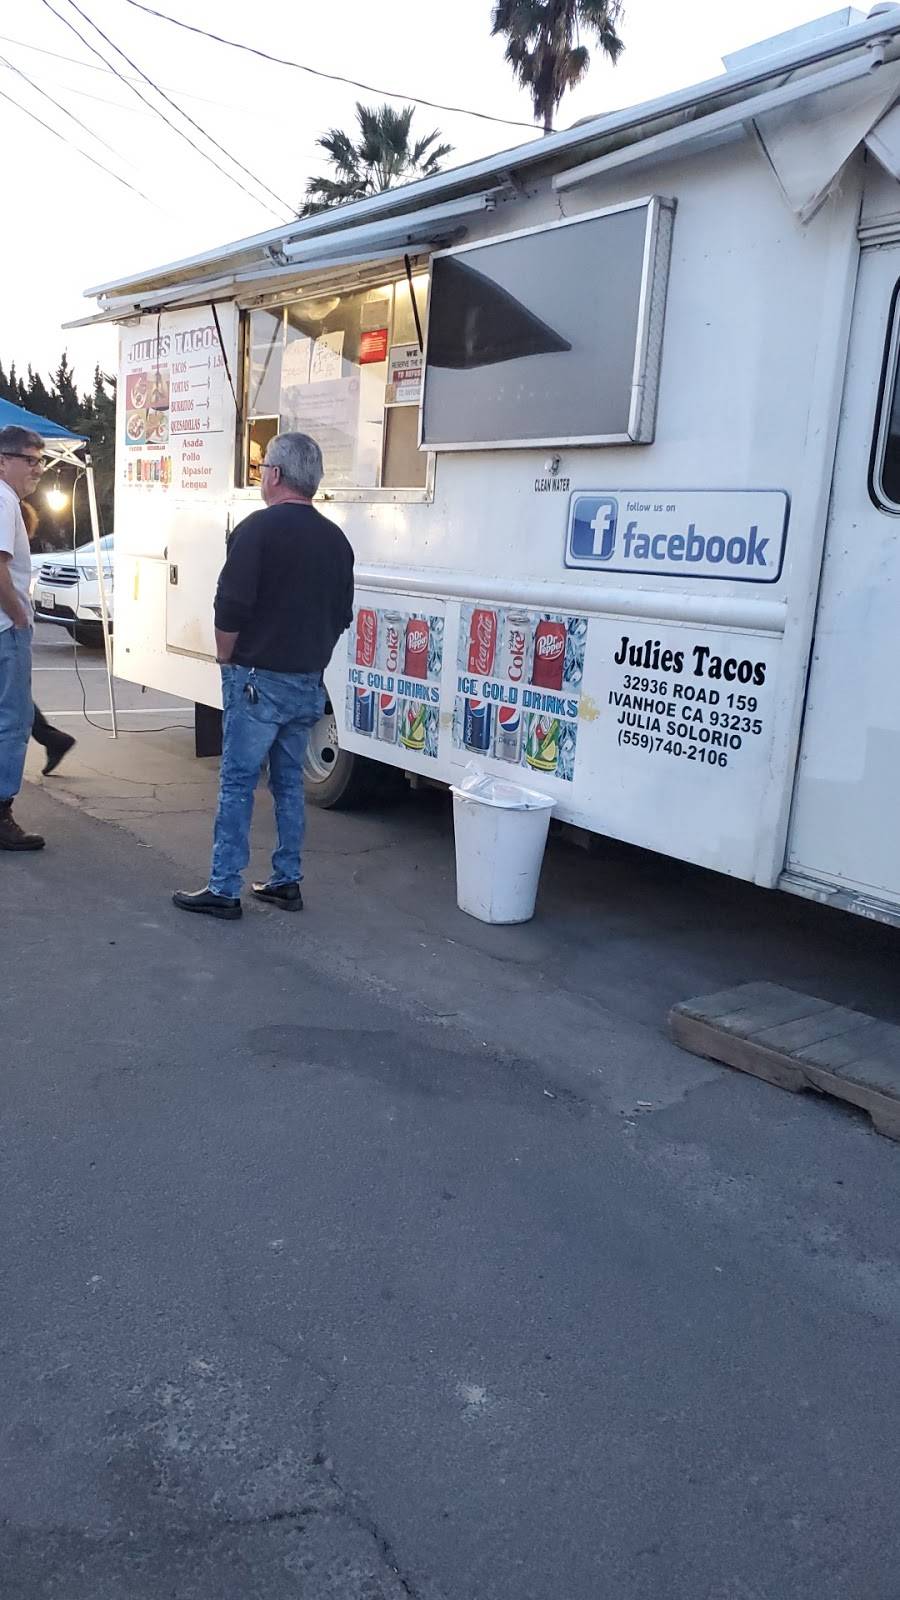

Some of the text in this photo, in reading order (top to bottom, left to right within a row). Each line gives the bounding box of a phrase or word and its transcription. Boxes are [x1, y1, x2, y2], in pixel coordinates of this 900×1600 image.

[128, 326, 220, 363] JULIES TACOS
[172, 360, 188, 374] TACOS
[406, 369, 421, 378] REFUS
[172, 380, 189, 394] TORTAS
[171, 400, 194, 413] BURRITOS
[170, 418, 200, 433] QUESADILLAS
[182, 438, 204, 448] Asada
[182, 452, 200, 462] Pollo
[182, 466, 212, 476] Alpastor
[182, 479, 208, 490] Lengua
[534, 478, 570, 492] CLEAN WATER
[626, 502, 676, 512] follow us on
[623, 521, 770, 567] facebook
[408, 632, 428, 651] Pepper
[414, 630, 423, 640] Dr
[546, 634, 558, 646] Dr
[386, 630, 399, 672] Coke
[537, 636, 563, 658] Pepper
[508, 632, 526, 682] Coke
[614, 636, 767, 686] Julies Tacos
[348, 668, 440, 703] ICE COLD DRINKS
[623, 674, 758, 713] 32936 ROAD 159
[457, 677, 578, 718] ICE COLD DRINKS
[608, 691, 763, 736] IVANHOE CA 93235
[617, 711, 743, 751] JULIA SOLORIO
[617, 729, 728, 768] (559)740-2106
